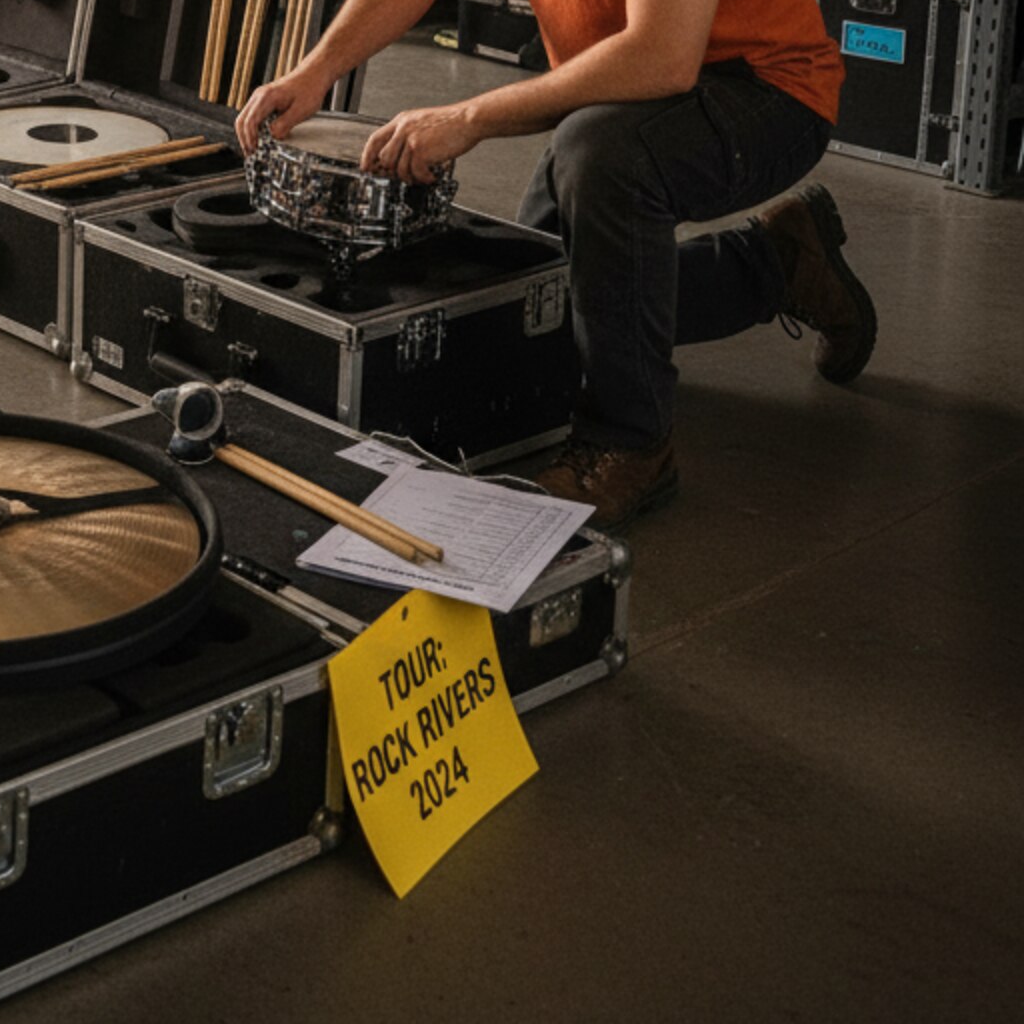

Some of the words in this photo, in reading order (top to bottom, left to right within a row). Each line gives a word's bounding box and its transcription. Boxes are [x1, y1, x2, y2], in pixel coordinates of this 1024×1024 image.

[378, 636, 448, 711] TOUR:
[351, 721, 418, 802] ROCK
[415, 656, 497, 749] RIVERS
[409, 745, 470, 821] 2024
